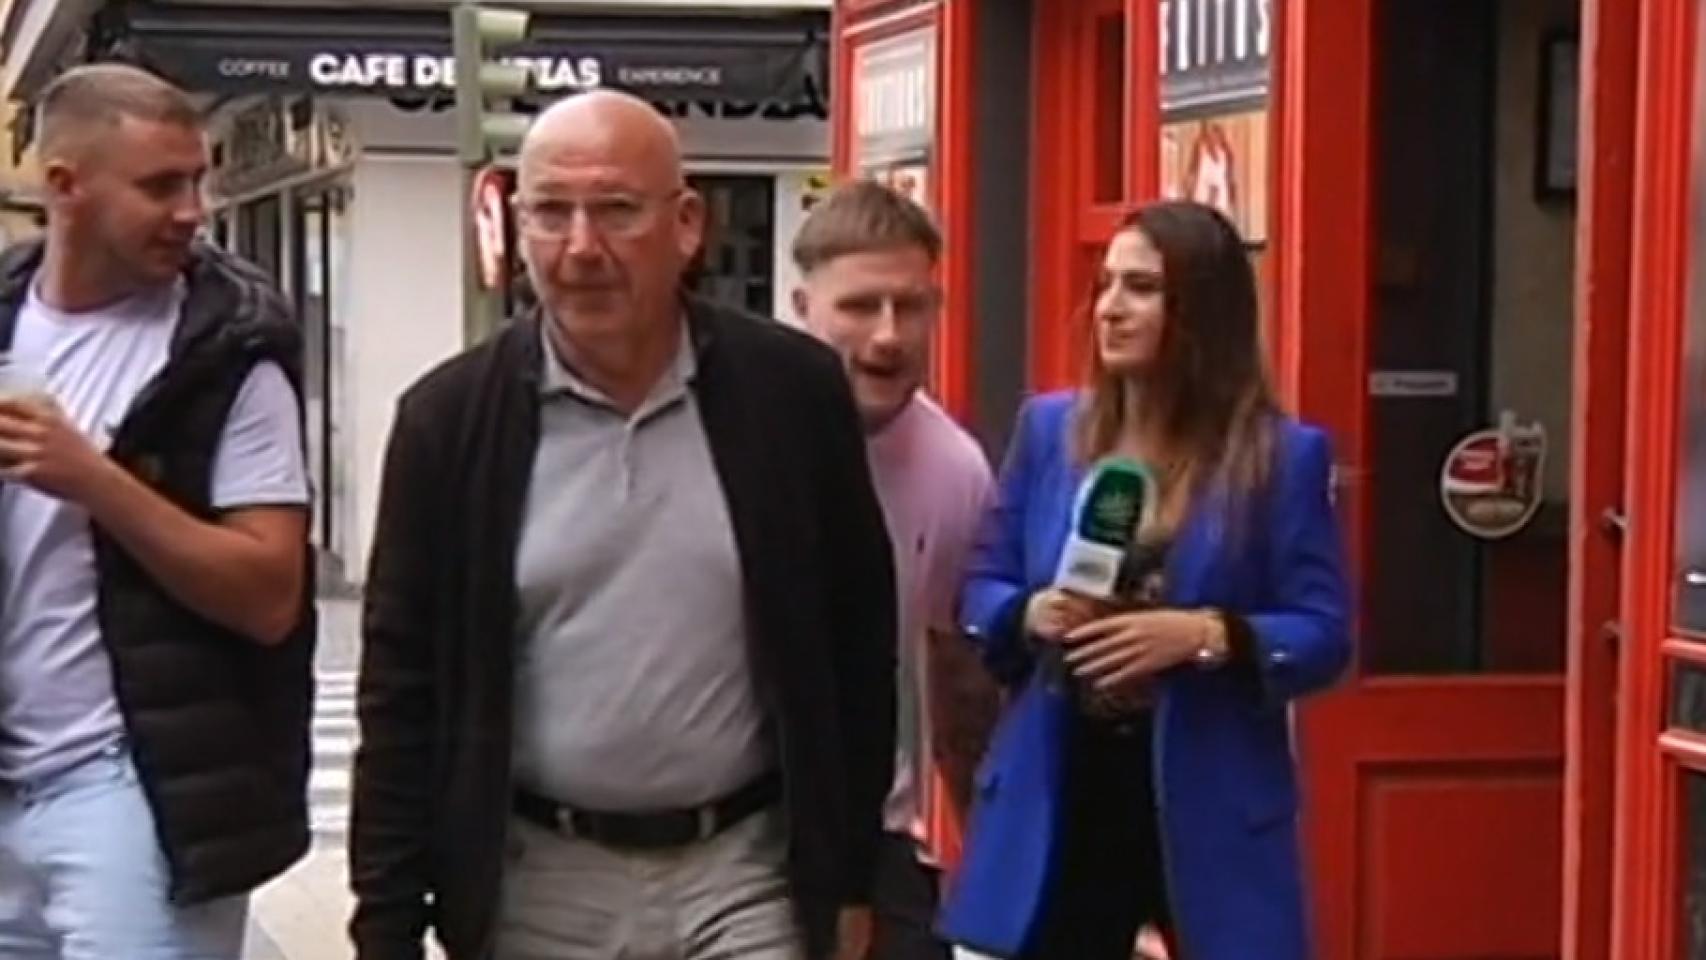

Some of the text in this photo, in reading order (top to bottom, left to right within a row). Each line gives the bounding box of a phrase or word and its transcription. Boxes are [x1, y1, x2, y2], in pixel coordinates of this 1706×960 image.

[218, 59, 290, 77] COFFEE
[309, 53, 406, 86] CAFE
[618, 67, 721, 85] EXPERIENCE
